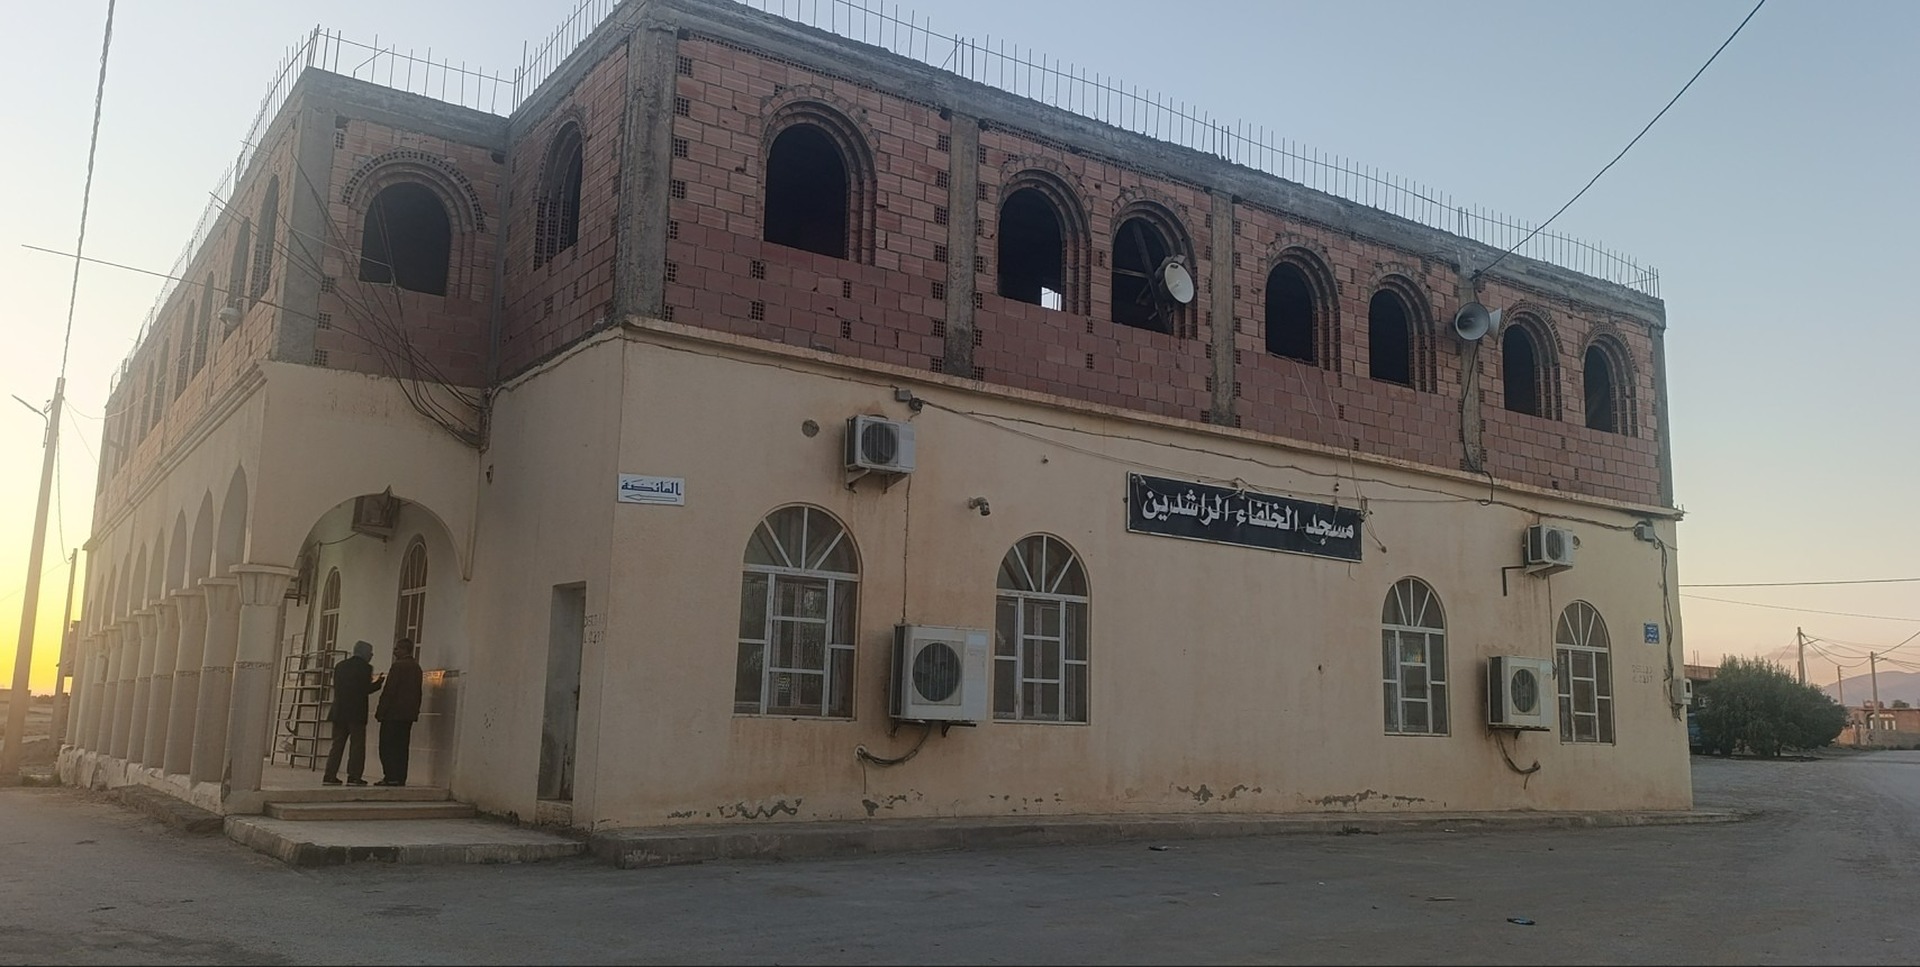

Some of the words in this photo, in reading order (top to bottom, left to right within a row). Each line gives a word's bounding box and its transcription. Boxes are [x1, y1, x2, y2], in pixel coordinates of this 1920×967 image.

[1142, 489, 1229, 526] الراشدين
[1236, 498, 1298, 532] الخلفاء
[1306, 513, 1355, 545] مسجد
